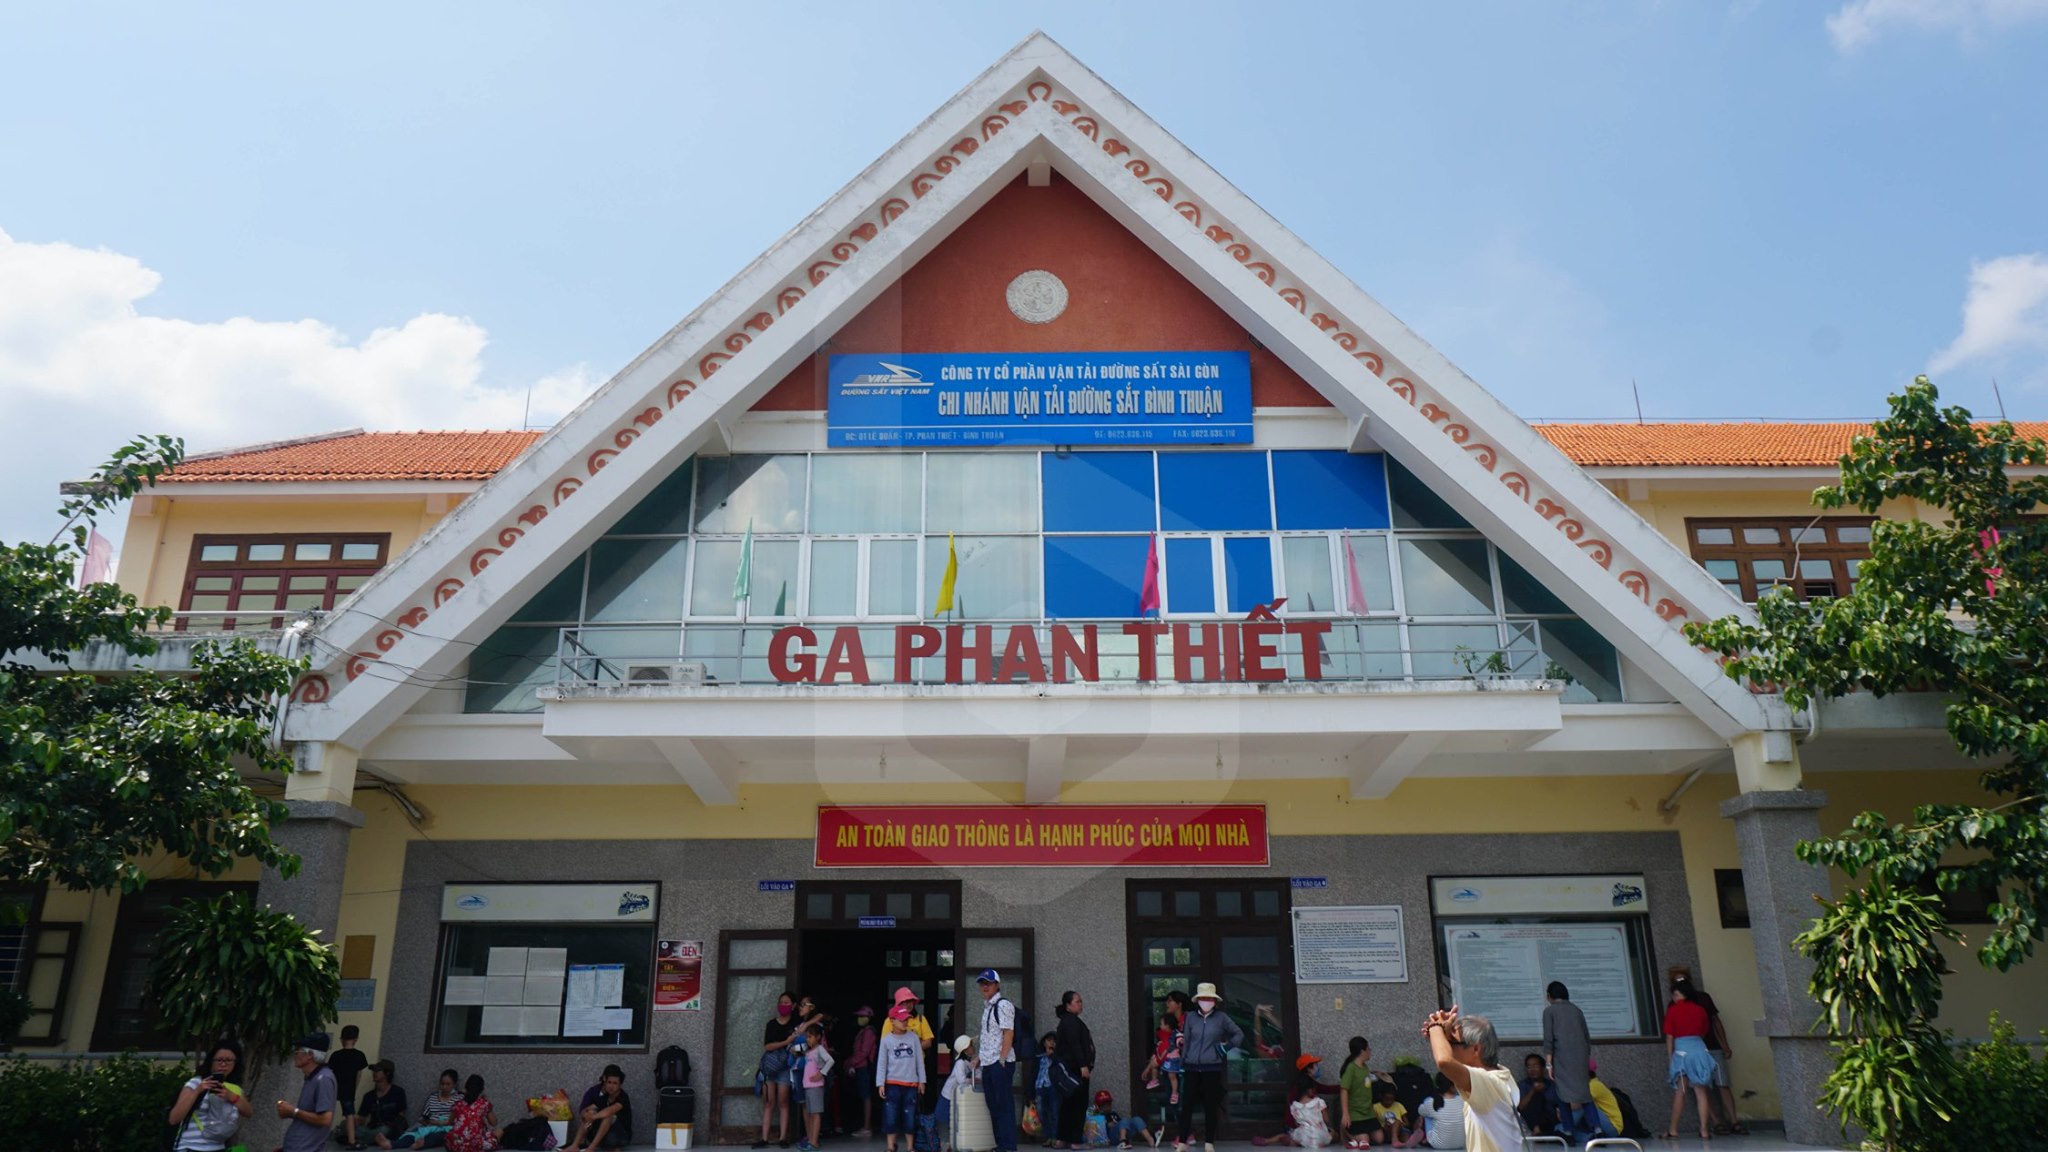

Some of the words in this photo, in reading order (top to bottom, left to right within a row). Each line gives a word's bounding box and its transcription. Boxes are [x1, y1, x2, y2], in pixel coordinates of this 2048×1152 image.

[941, 364, 972, 380] CÔNG
[976, 366, 991, 380] TY
[994, 360, 1010, 380] CỔ
[1013, 362, 1045, 380] PHẦN
[1048, 363, 1074, 382] VẬN
[1076, 361, 1097, 379] TẢI
[1100, 361, 1140, 379] ĐƯỜNG
[1143, 361, 1167, 379] SẮT
[1170, 362, 1190, 379] SÀI
[1195, 362, 1219, 379] GÒN
[938, 390, 960, 416] CHI
[964, 386, 1009, 416] NHÁNH
[1013, 386, 1040, 420] VẬN
[1043, 384, 1065, 415] TẢI
[1068, 384, 1112, 415] ĐƯỜNG
[1116, 382, 1140, 414] SẮT
[1144, 385, 1175, 414] BÌNH
[1179, 385, 1223, 418] THUẬN
[767, 625, 870, 684] GA
[894, 624, 1099, 684] PHAN
[1123, 598, 1332, 683] THIẾT
[836, 825, 858, 847] AN
[863, 819, 906, 847] TOÀN
[911, 824, 949, 847] GIAO
[954, 819, 1009, 847] THÔNG
[1015, 818, 1034, 847] LÀ
[1040, 824, 1084, 852] HẠNH
[1090, 818, 1134, 847] PHÚC
[1140, 817, 1174, 847] CỦA
[1178, 824, 1210, 852] MỌI
[1215, 818, 1250, 847] NHÀ
